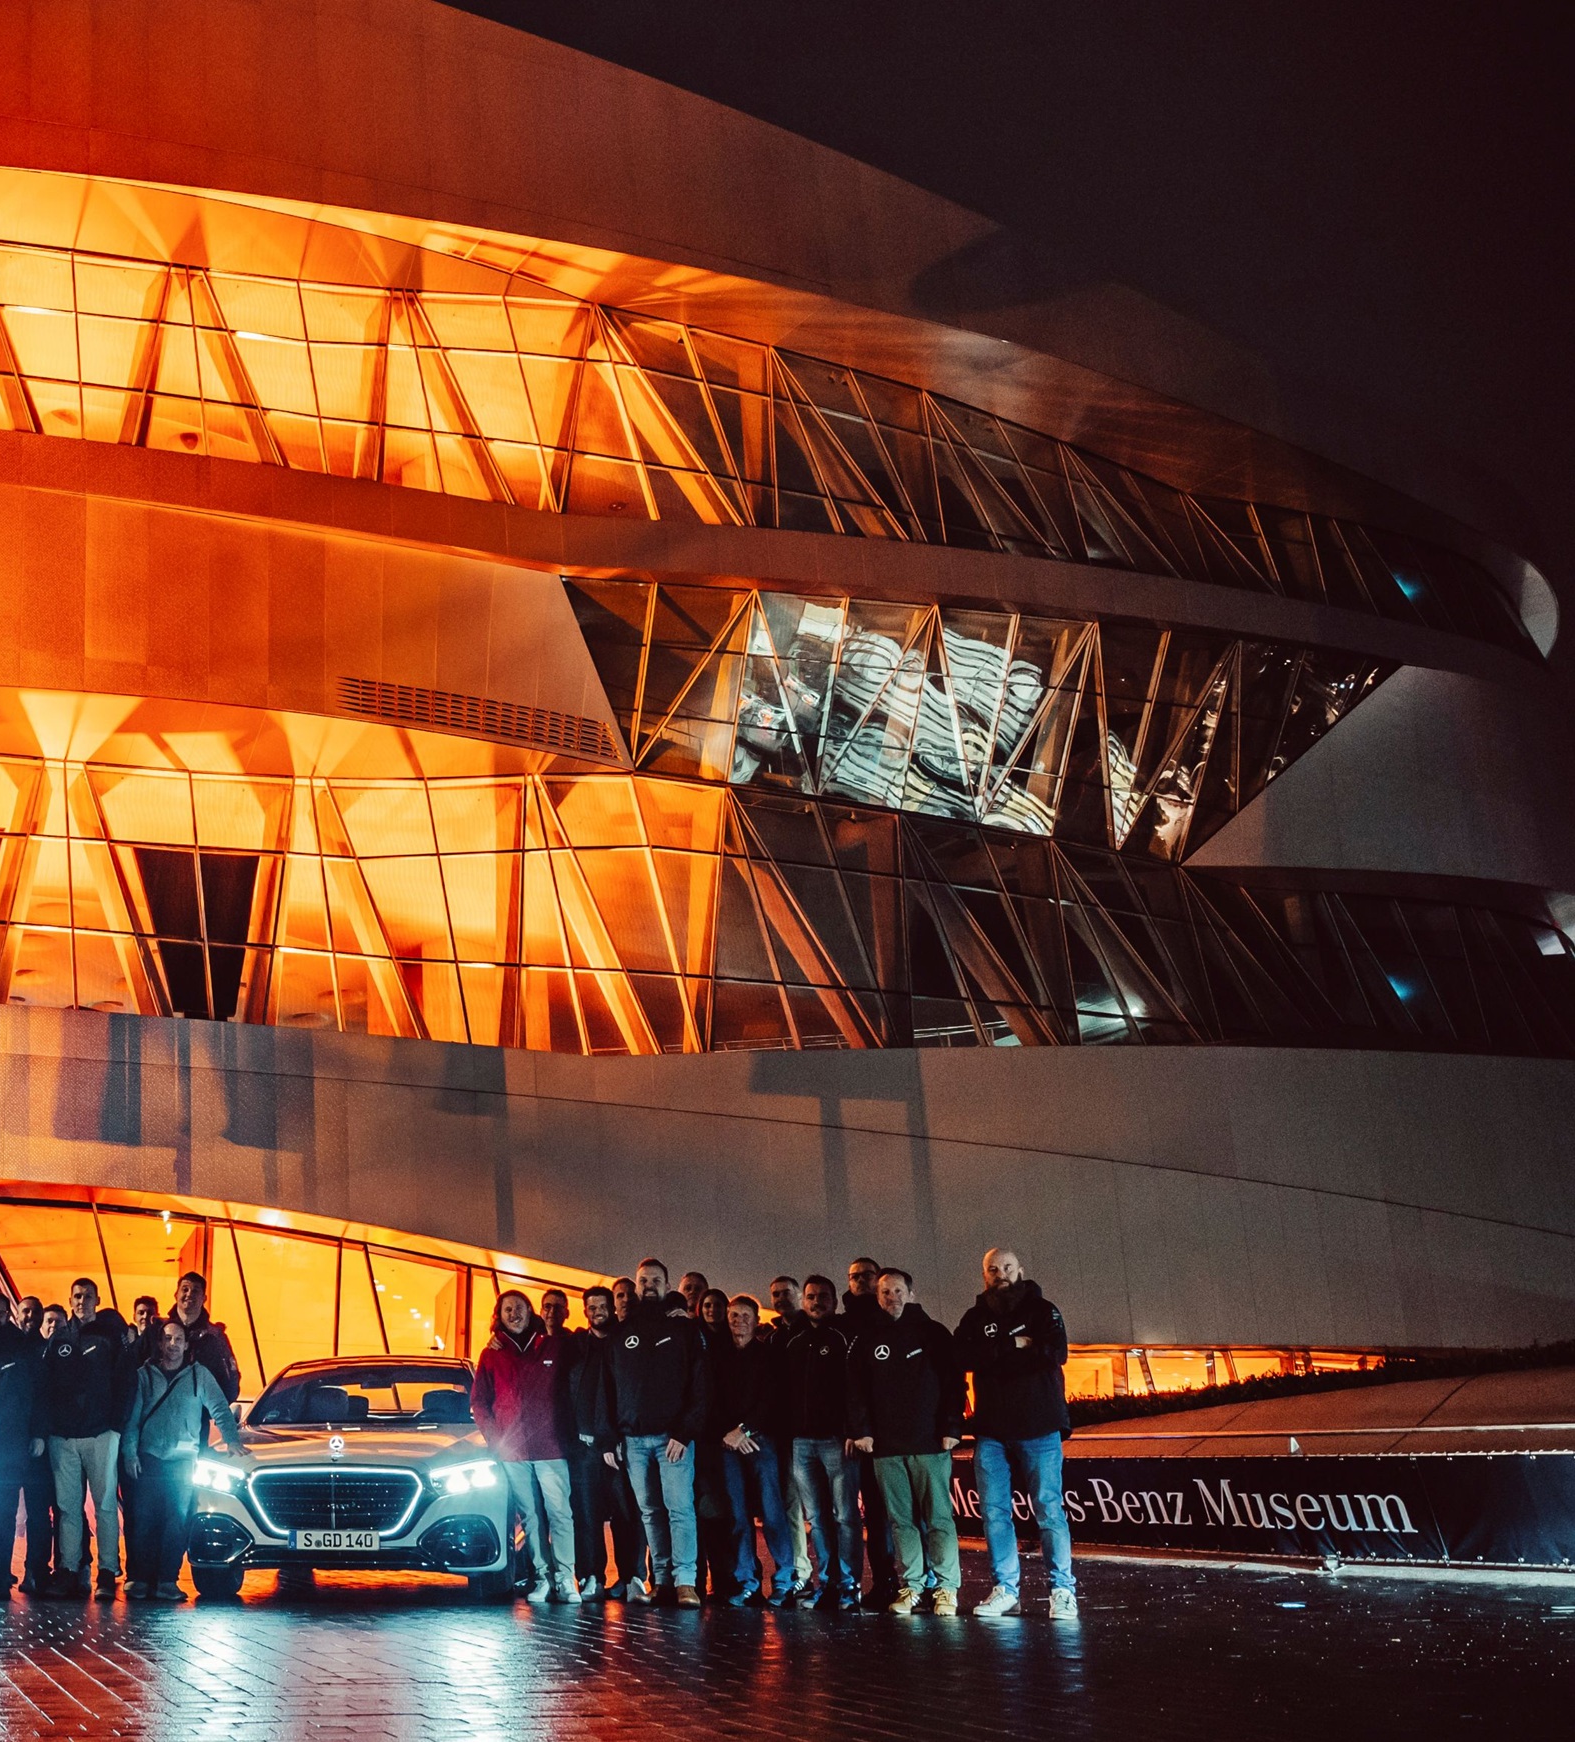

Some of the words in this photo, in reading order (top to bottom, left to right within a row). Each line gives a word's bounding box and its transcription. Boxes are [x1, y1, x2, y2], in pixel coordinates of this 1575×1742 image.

[949, 1477, 1192, 1526] Mees-Benz
[1193, 1478, 1419, 1534] Museum
[303, 1533, 313, 1548] S
[322, 1533, 342, 1548] GD
[345, 1533, 373, 1548] 140
